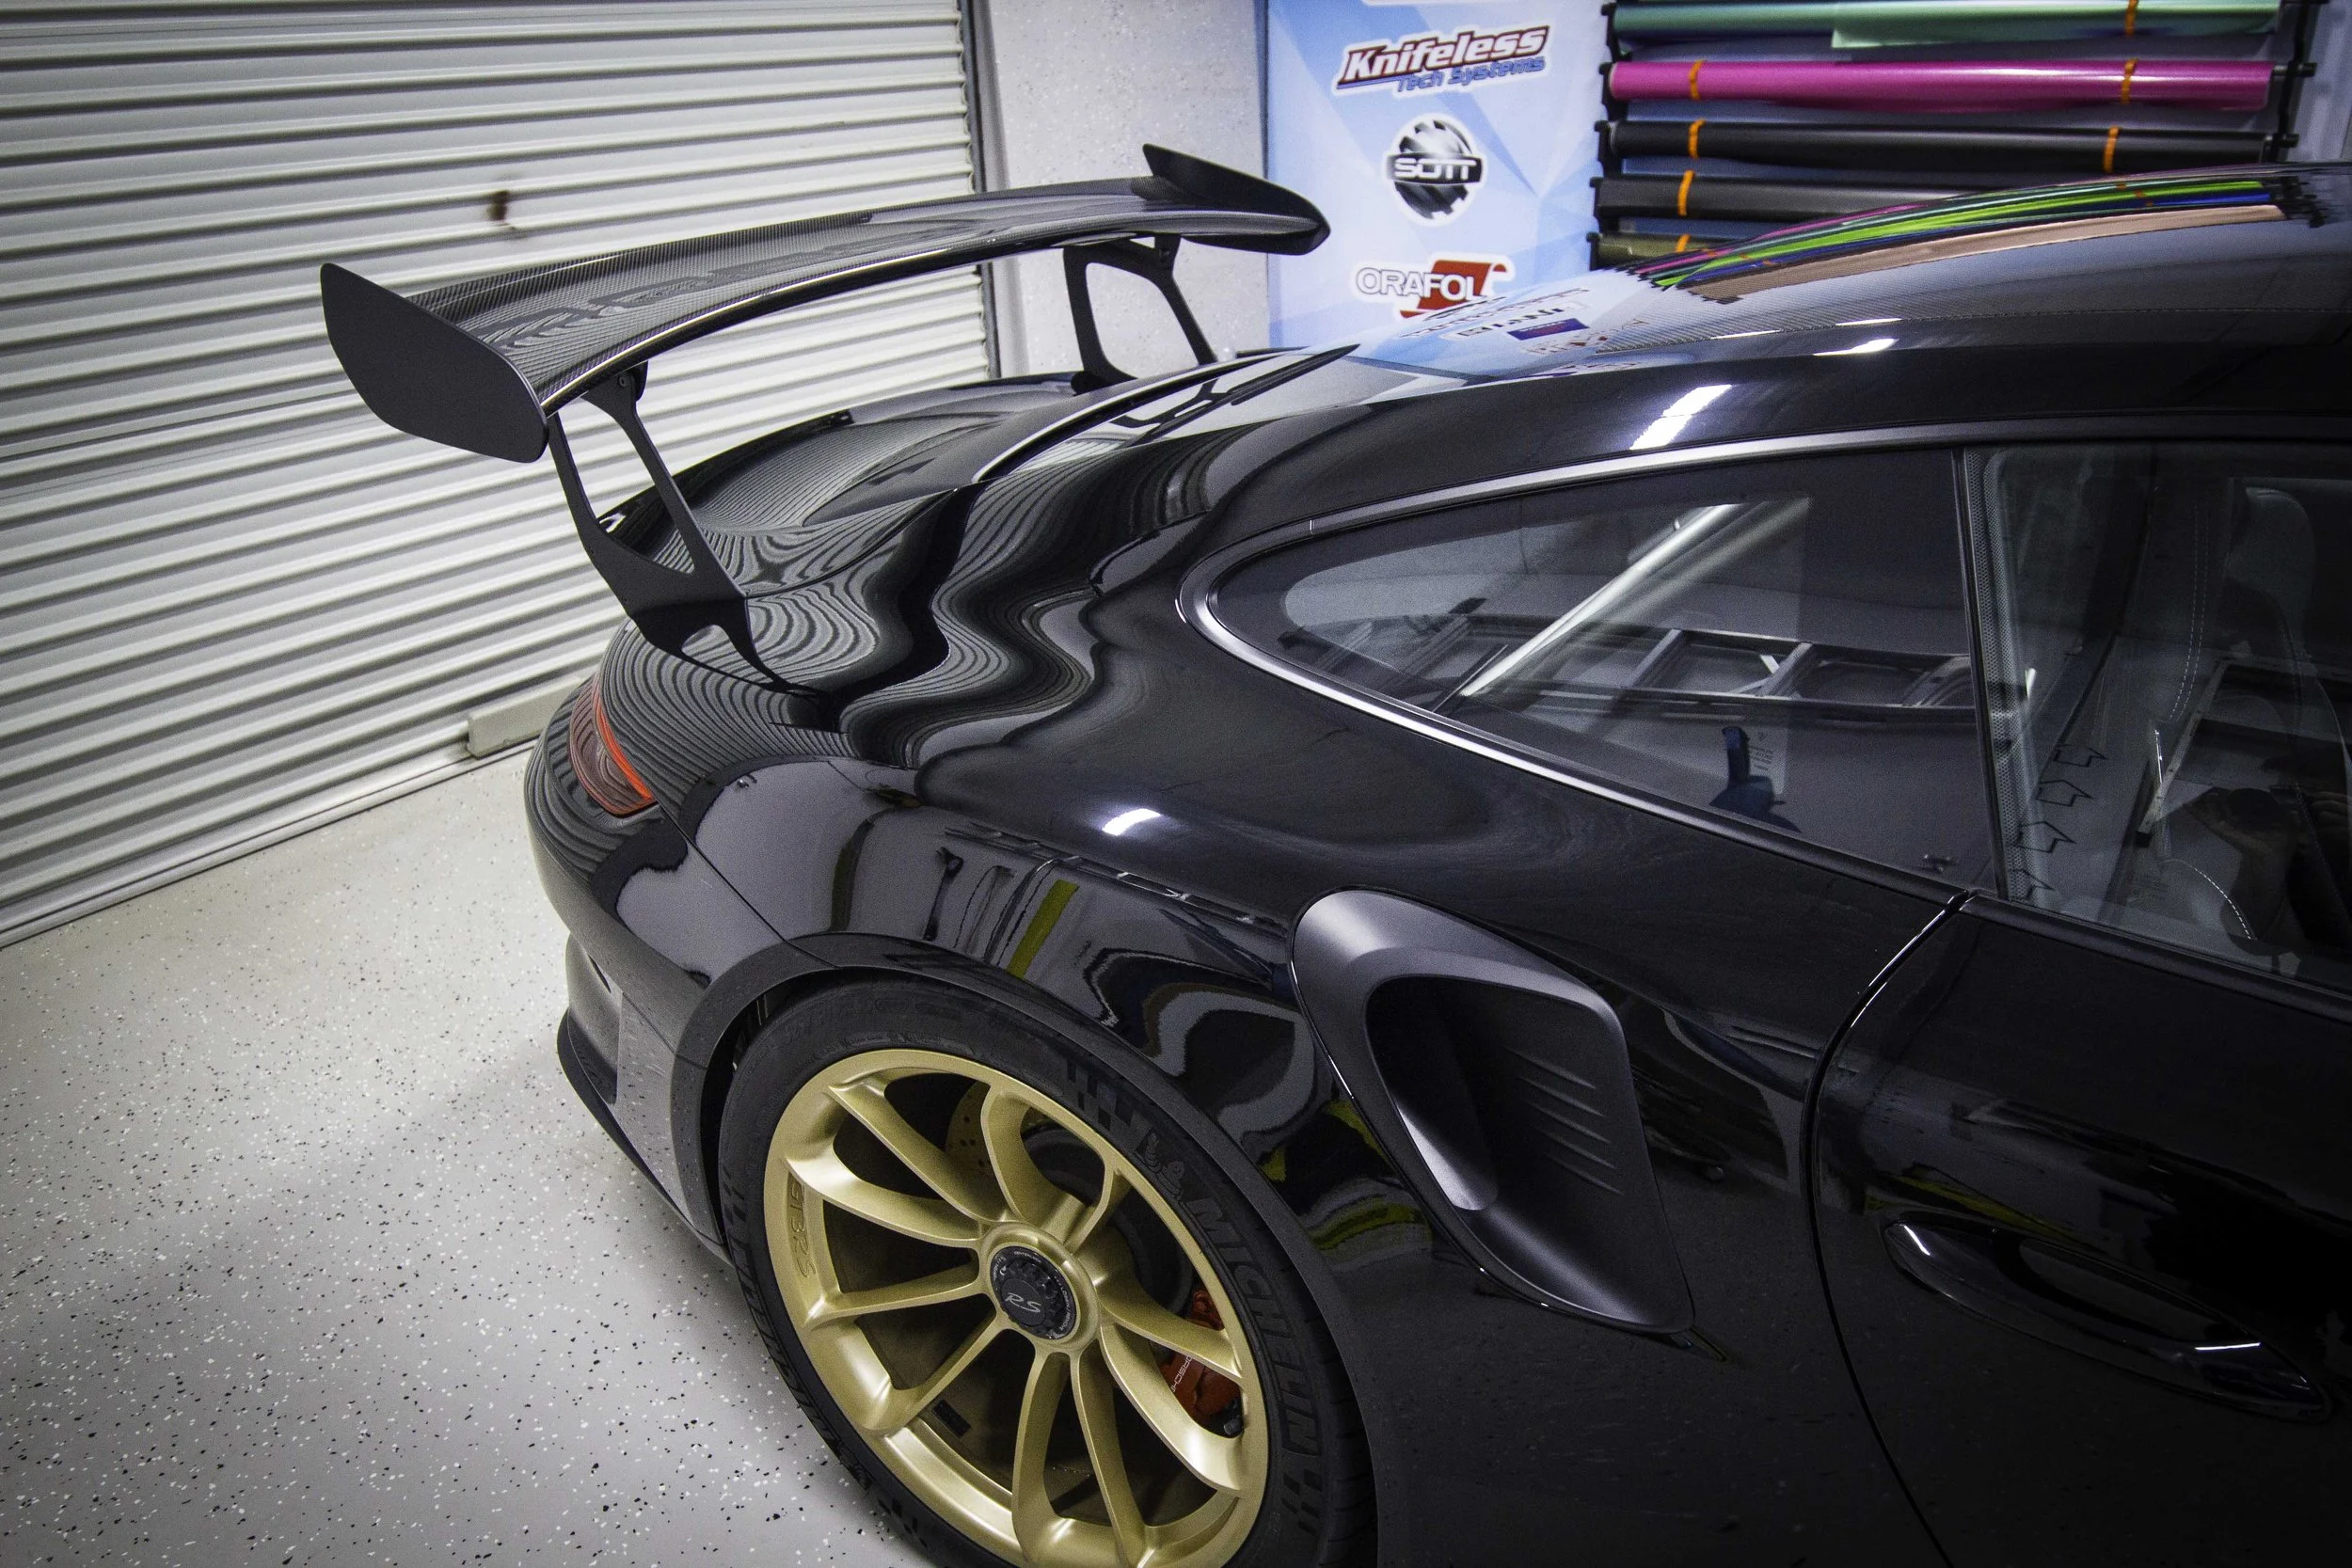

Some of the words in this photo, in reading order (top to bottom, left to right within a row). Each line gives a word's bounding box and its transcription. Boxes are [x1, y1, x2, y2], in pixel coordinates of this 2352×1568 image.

[1337, 25, 1549, 85] Knifeless
[1397, 71, 1445, 92] Tech
[1448, 56, 1546, 86] Systems
[1356, 267, 1486, 301] ORAFOL
[1005, 1292, 1041, 1312] RS
[1186, 1197, 1320, 1455] MICHELIN
[1169, 1355, 1193, 1392] ORSCH
